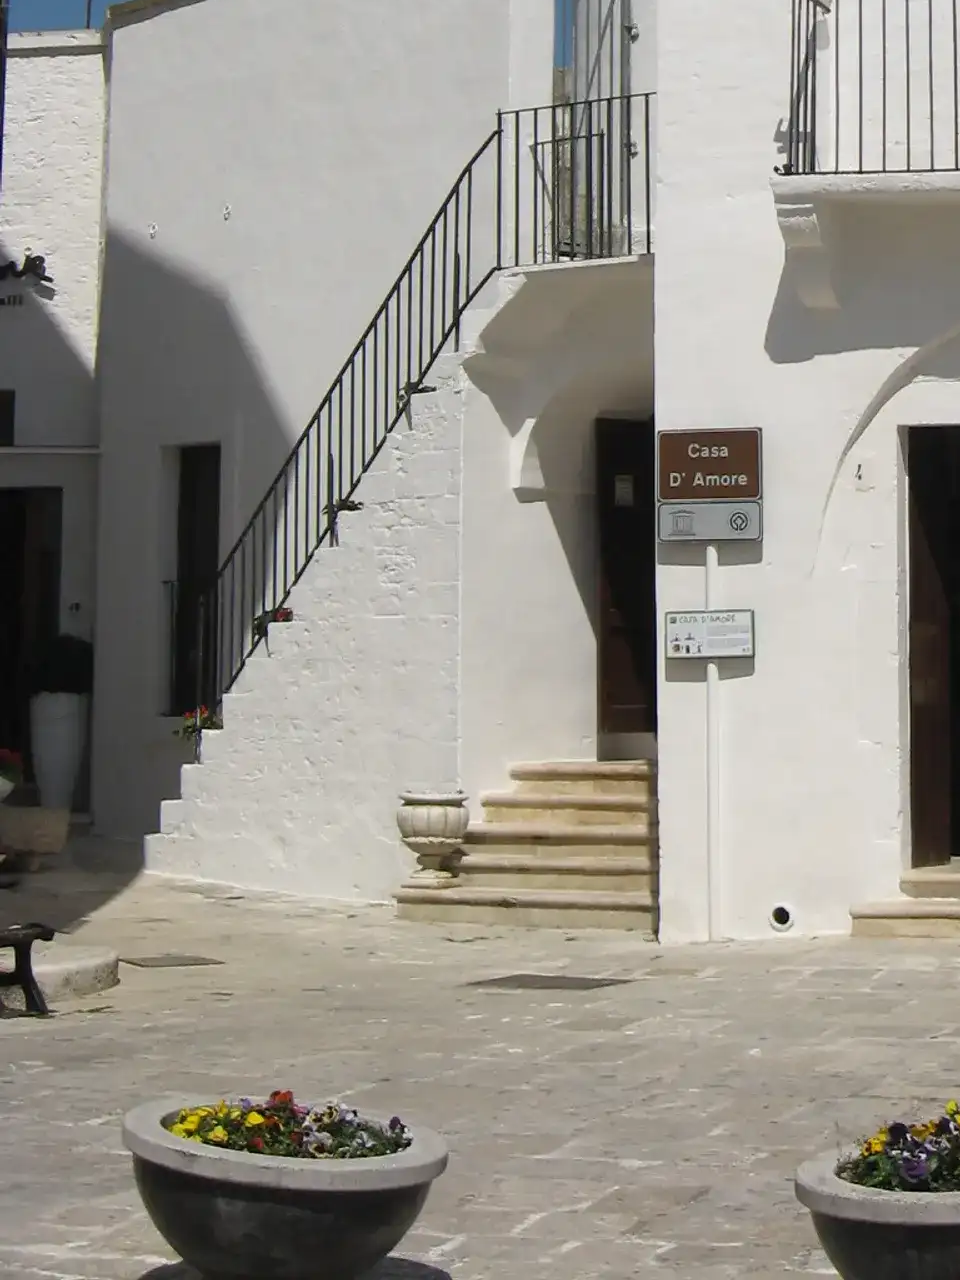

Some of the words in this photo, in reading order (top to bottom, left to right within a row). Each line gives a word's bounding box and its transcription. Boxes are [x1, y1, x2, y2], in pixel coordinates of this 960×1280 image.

[687, 443, 729, 458] Casa
[669, 472, 686, 487] D'
[692, 472, 748, 487] Amore
